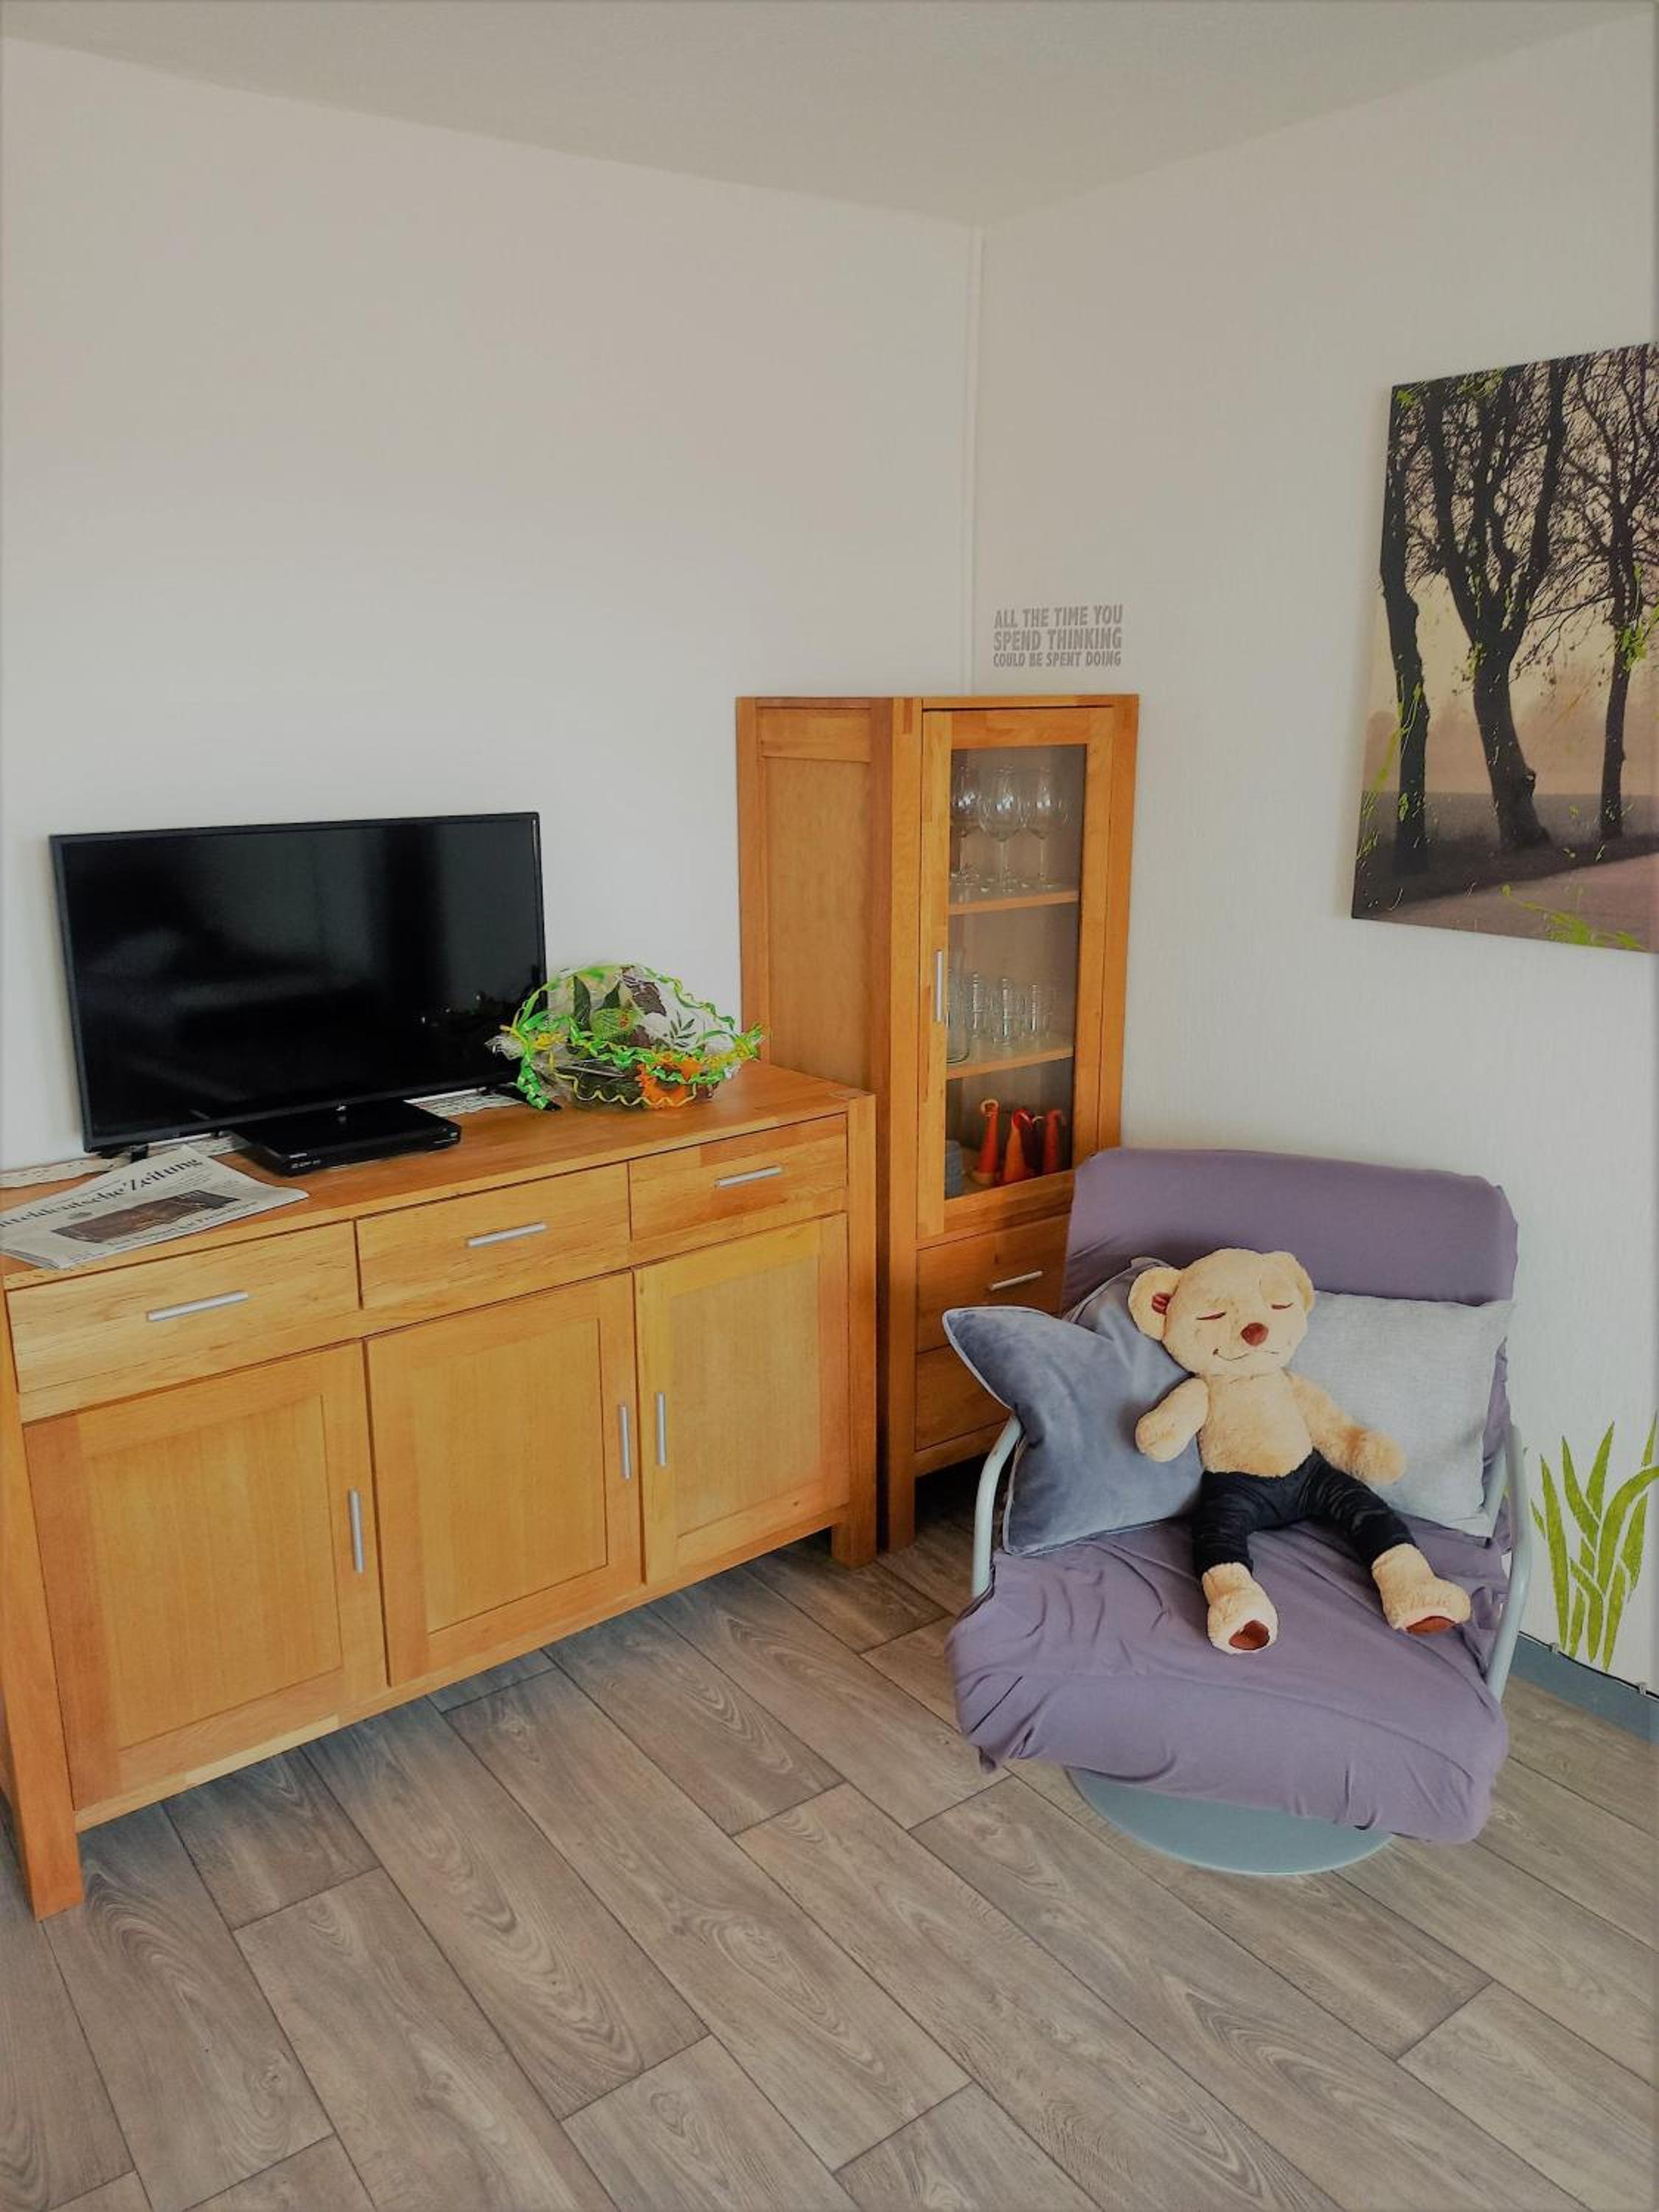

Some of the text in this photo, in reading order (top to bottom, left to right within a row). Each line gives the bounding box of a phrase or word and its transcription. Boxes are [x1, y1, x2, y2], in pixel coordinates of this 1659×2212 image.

[994, 604, 1123, 627] ALL THE TIME YOU
[994, 627, 1121, 651] SPEND THINKING
[994, 650, 1121, 667] COULD BE SPENT DOING
